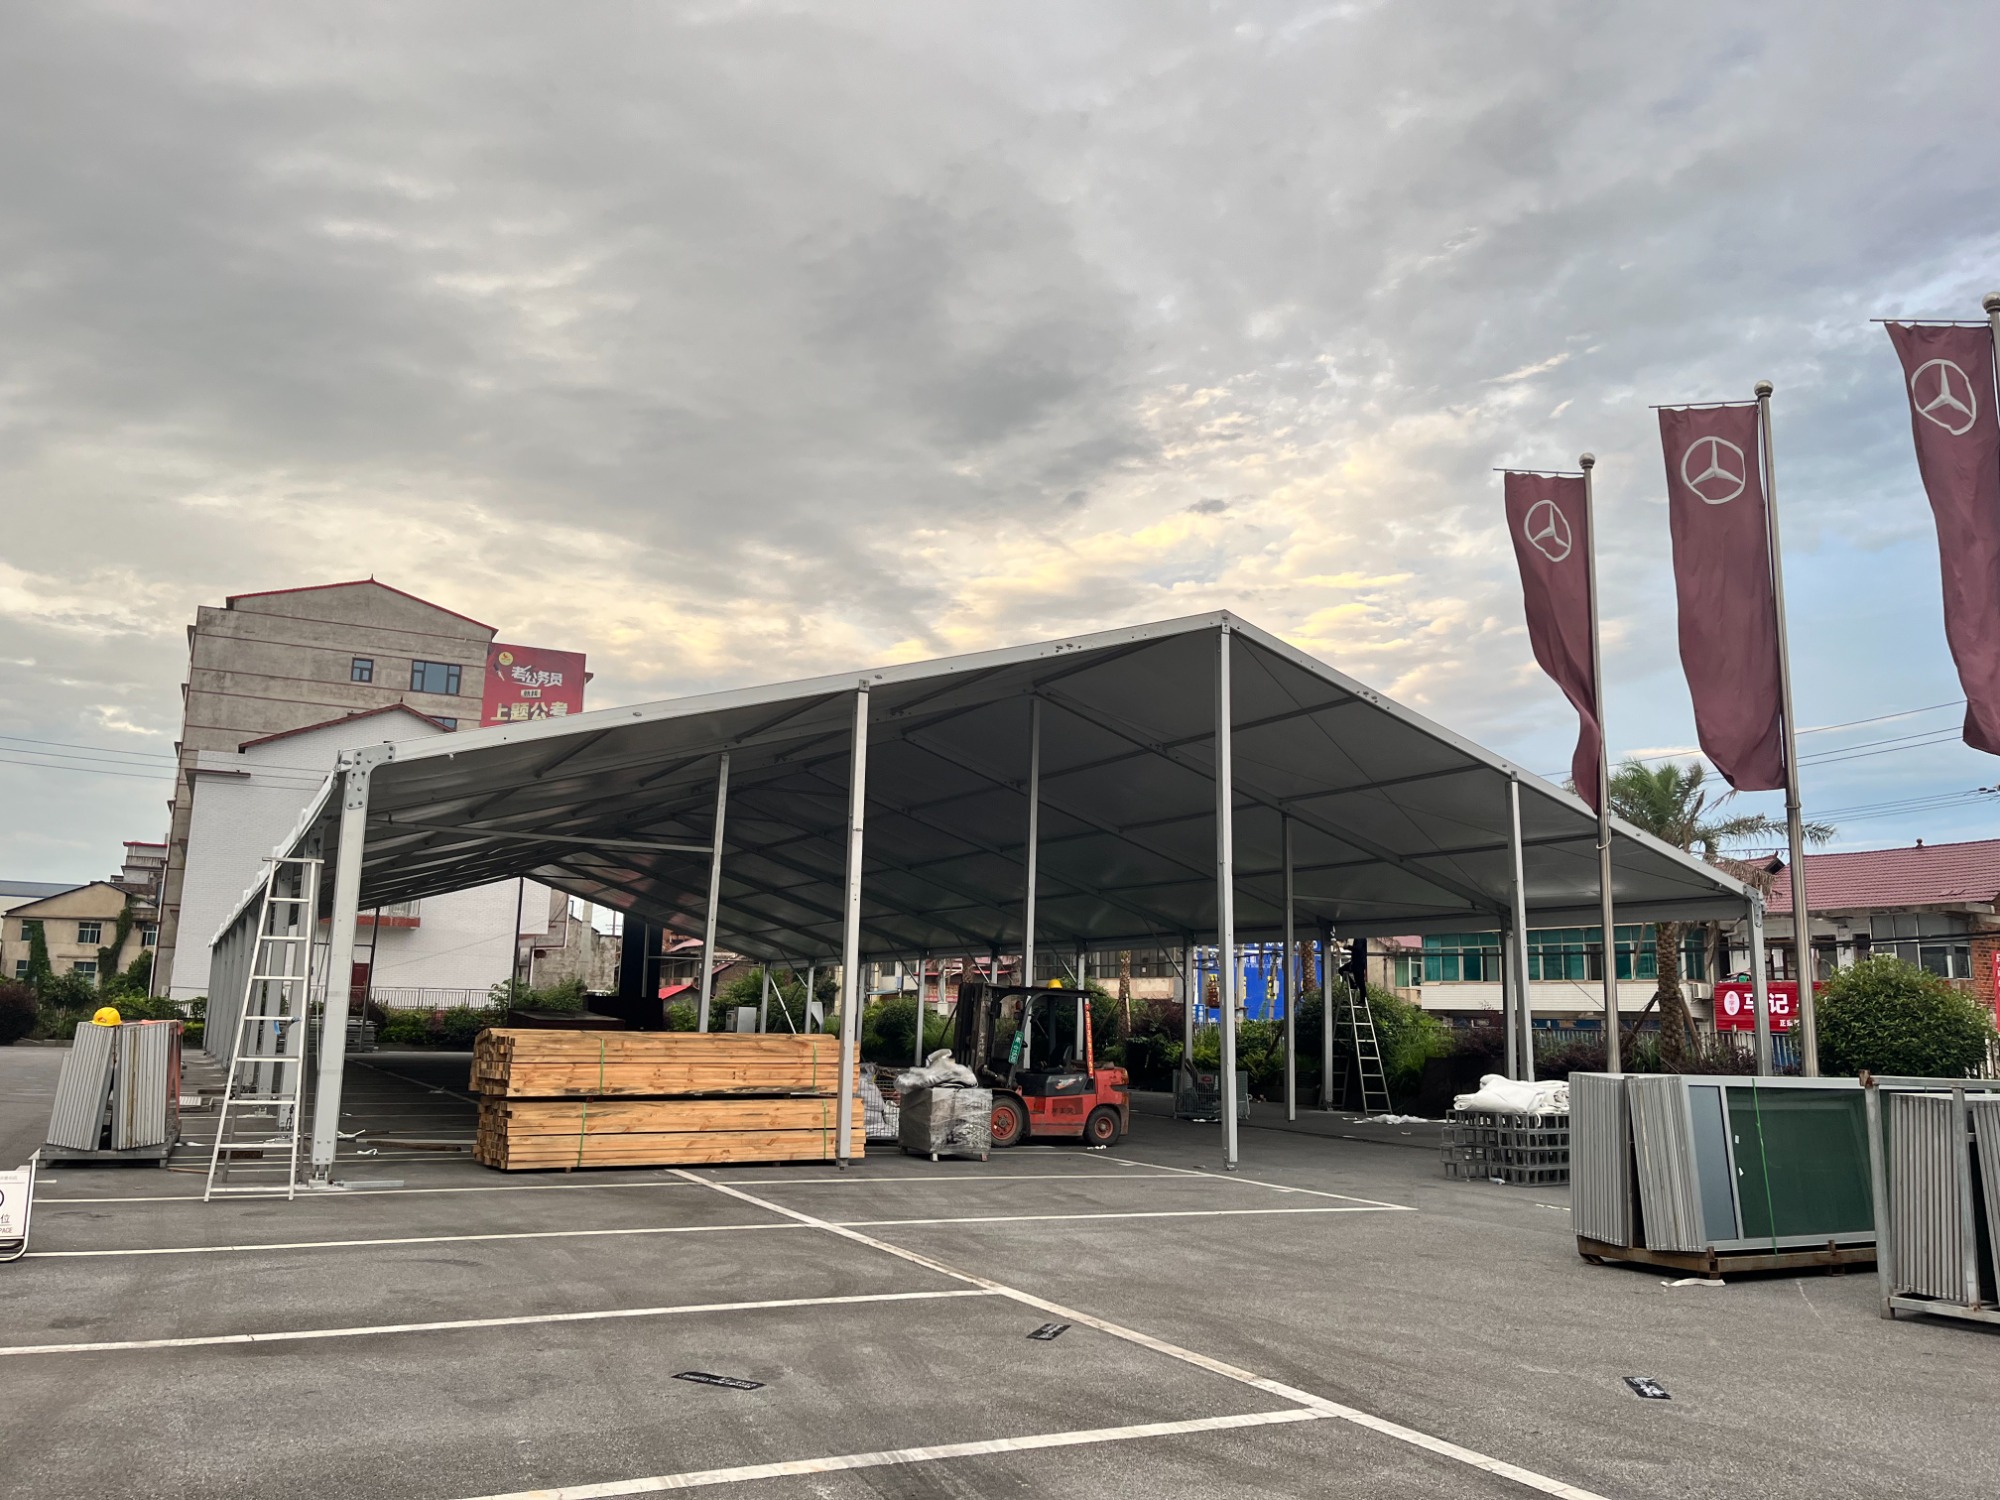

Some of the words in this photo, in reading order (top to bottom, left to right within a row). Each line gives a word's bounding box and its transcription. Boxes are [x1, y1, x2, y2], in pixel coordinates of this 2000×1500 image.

[511, 665, 562, 687] 考公务员
[490, 702, 568, 720] 上题公考
